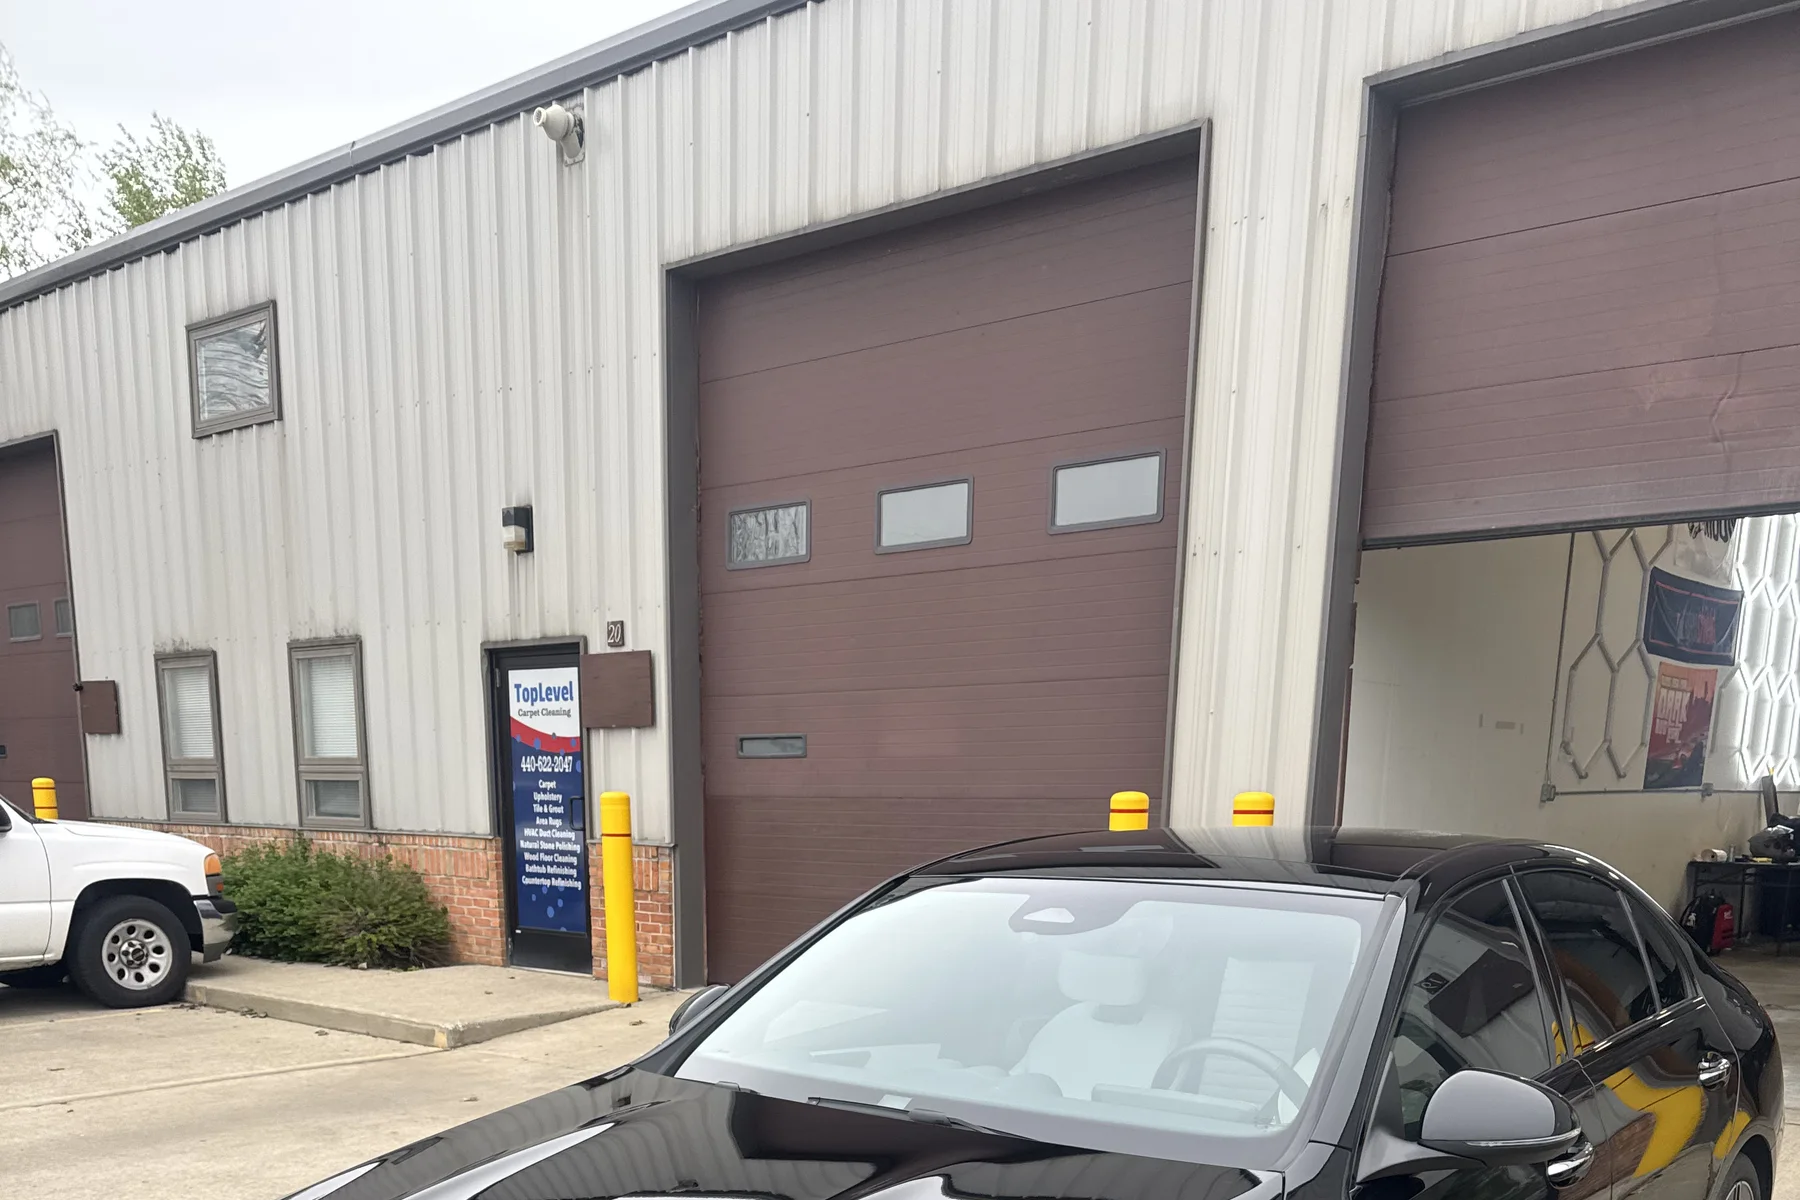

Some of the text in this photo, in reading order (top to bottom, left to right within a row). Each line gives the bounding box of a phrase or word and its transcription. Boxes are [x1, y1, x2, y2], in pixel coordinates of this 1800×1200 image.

[608, 624, 621, 642] 20
[514, 681, 573, 706] TopLevel
[518, 707, 571, 718] Carpet Cleaning
[521, 755, 573, 772] 440-622-2047
[538, 779, 556, 790] Carpet
[533, 792, 562, 803] Upholstery
[533, 804, 564, 814] Tile & Grout
[536, 816, 562, 828] Area Rugs
[524, 828, 575, 841] HVAC Duct Cleaning
[520, 840, 580, 853] Natural Stone Polishing
[524, 852, 577, 865] Wood Floor Cleaning
[525, 864, 577, 877] Bathtub Refinishing
[522, 875, 581, 890] Countertop Refinishing
